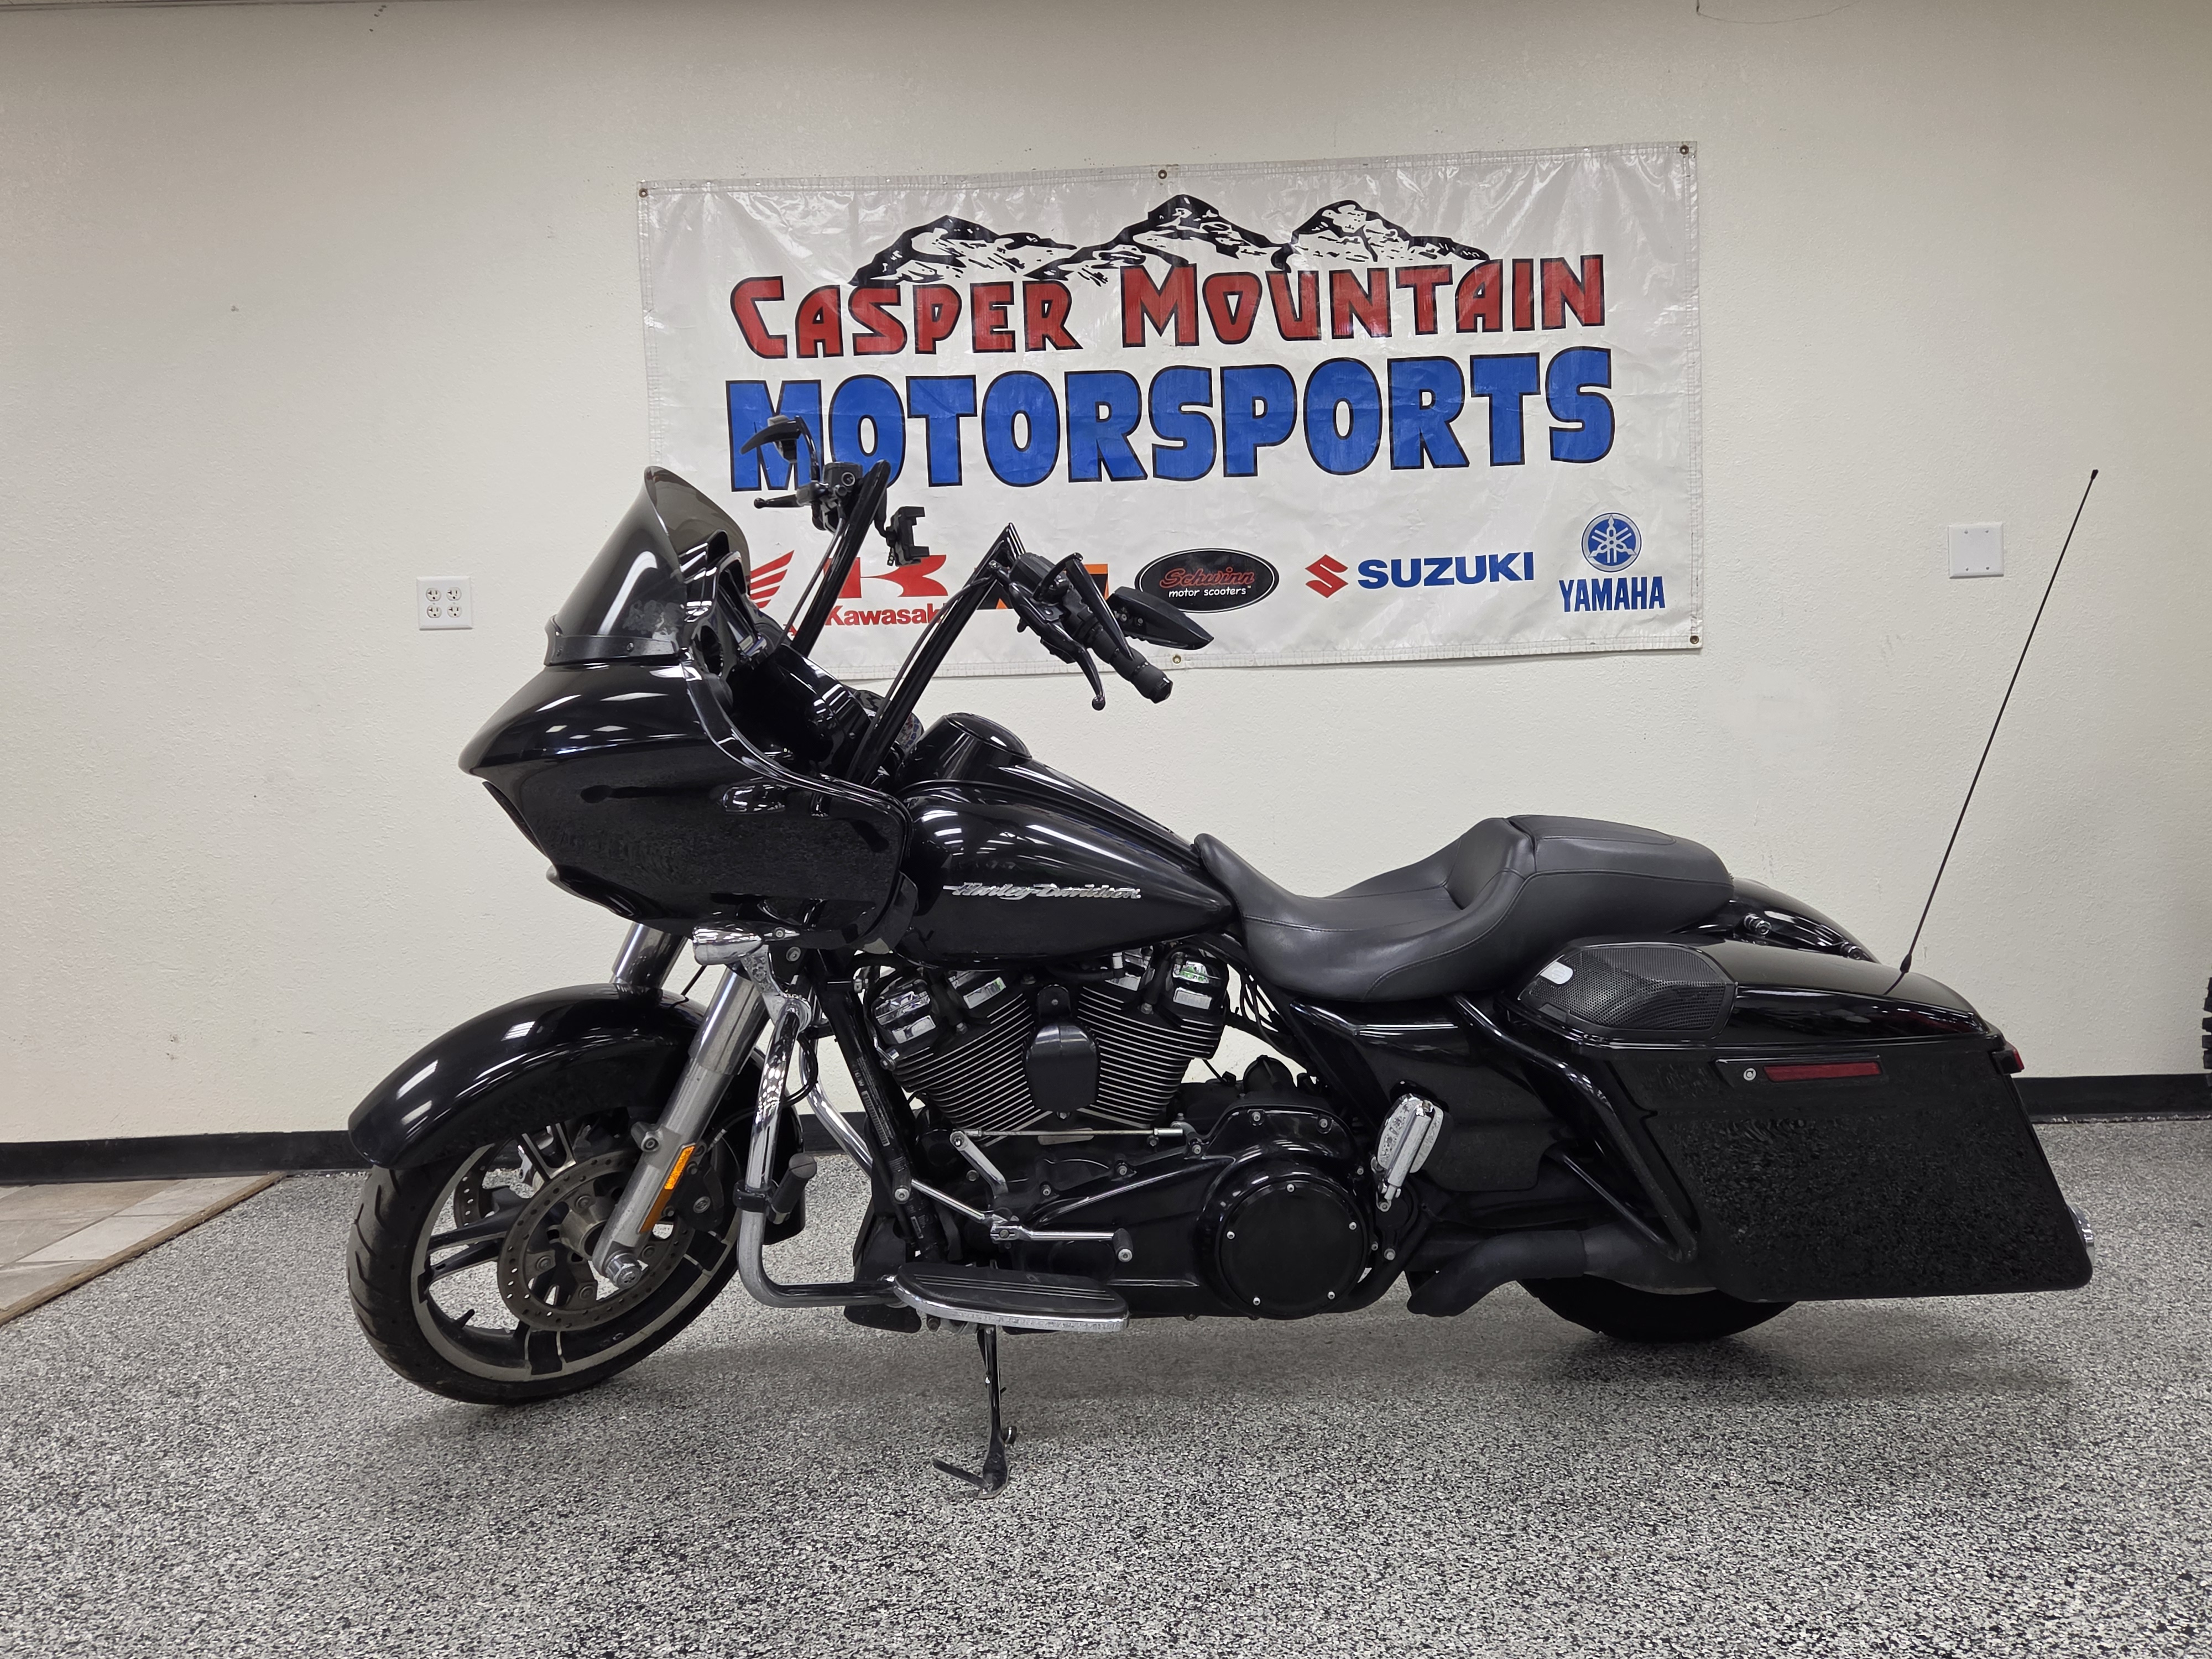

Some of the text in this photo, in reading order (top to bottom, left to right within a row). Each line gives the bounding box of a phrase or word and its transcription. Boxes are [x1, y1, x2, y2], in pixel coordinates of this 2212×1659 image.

[730, 254, 1605, 359] CASPER MOUNTAIN
[726, 346, 1615, 492] MOTORSPORTS
[1159, 566, 1255, 588] Schwinn
[1358, 551, 1534, 589] SUZUKI
[1168, 586, 1246, 598] motor scooters
[1559, 576, 1666, 613] YAMAHA
[825, 603, 947, 626] Kawasak
